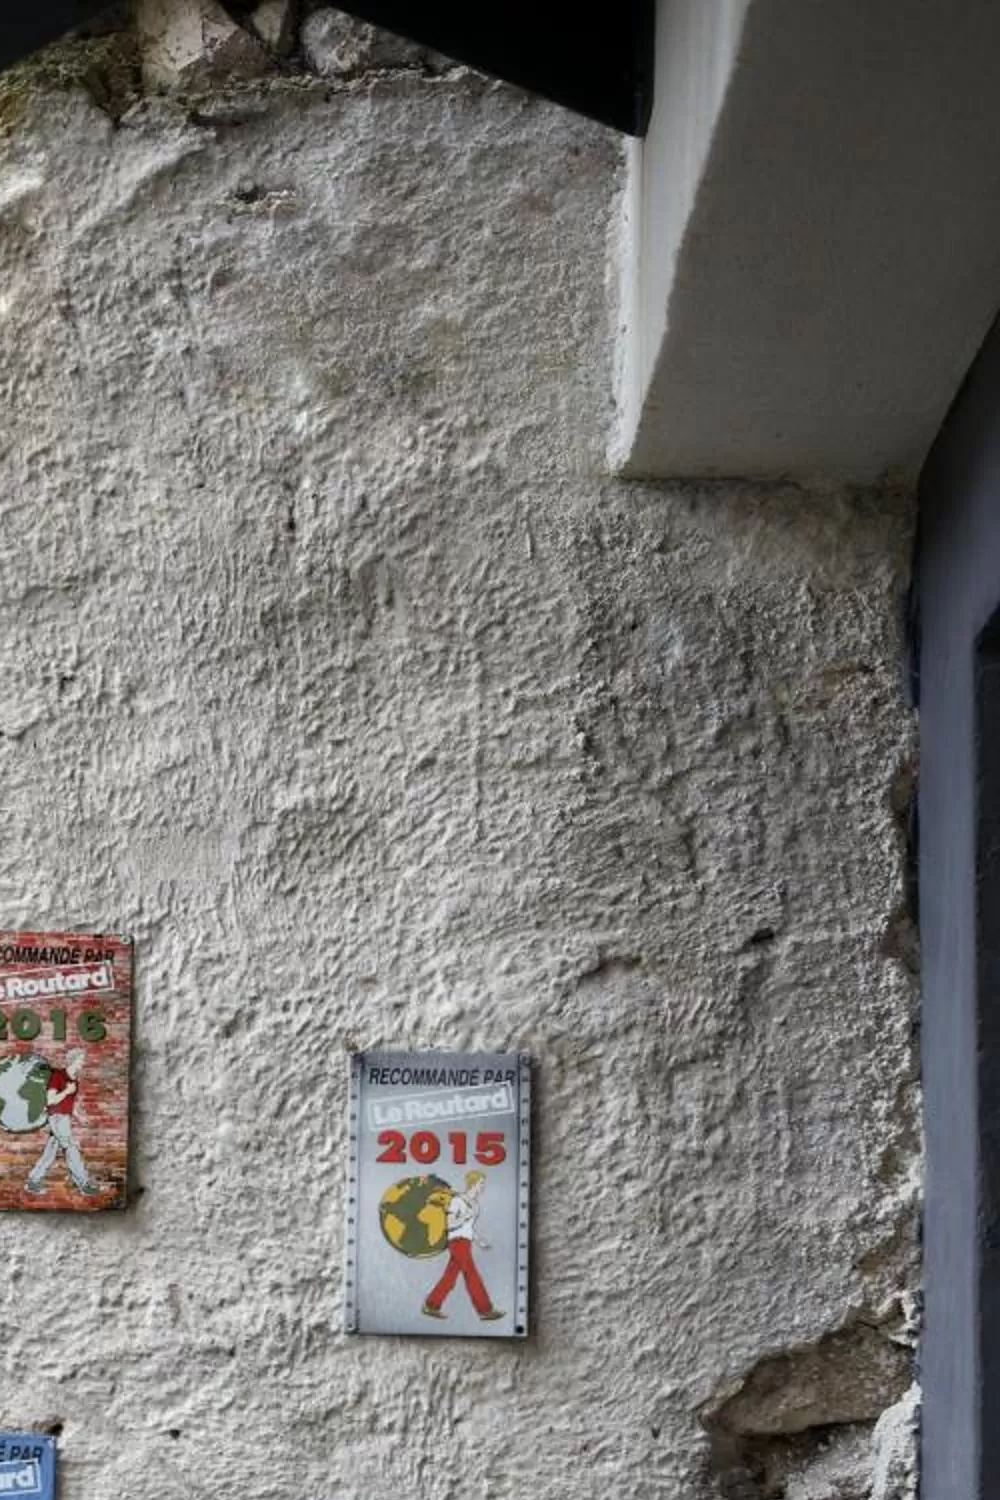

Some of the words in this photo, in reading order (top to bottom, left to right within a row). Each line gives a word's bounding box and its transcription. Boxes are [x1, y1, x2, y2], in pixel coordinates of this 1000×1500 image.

[84, 949, 114, 964] PAR
[6, 966, 108, 998] Routard
[369, 1067, 479, 1087] RECOMMANDÉ
[483, 1069, 516, 1087] PAR
[404, 1087, 508, 1120] Routard
[376, 1130, 507, 1166] 2015
[10, 1446, 43, 1463] PAR
